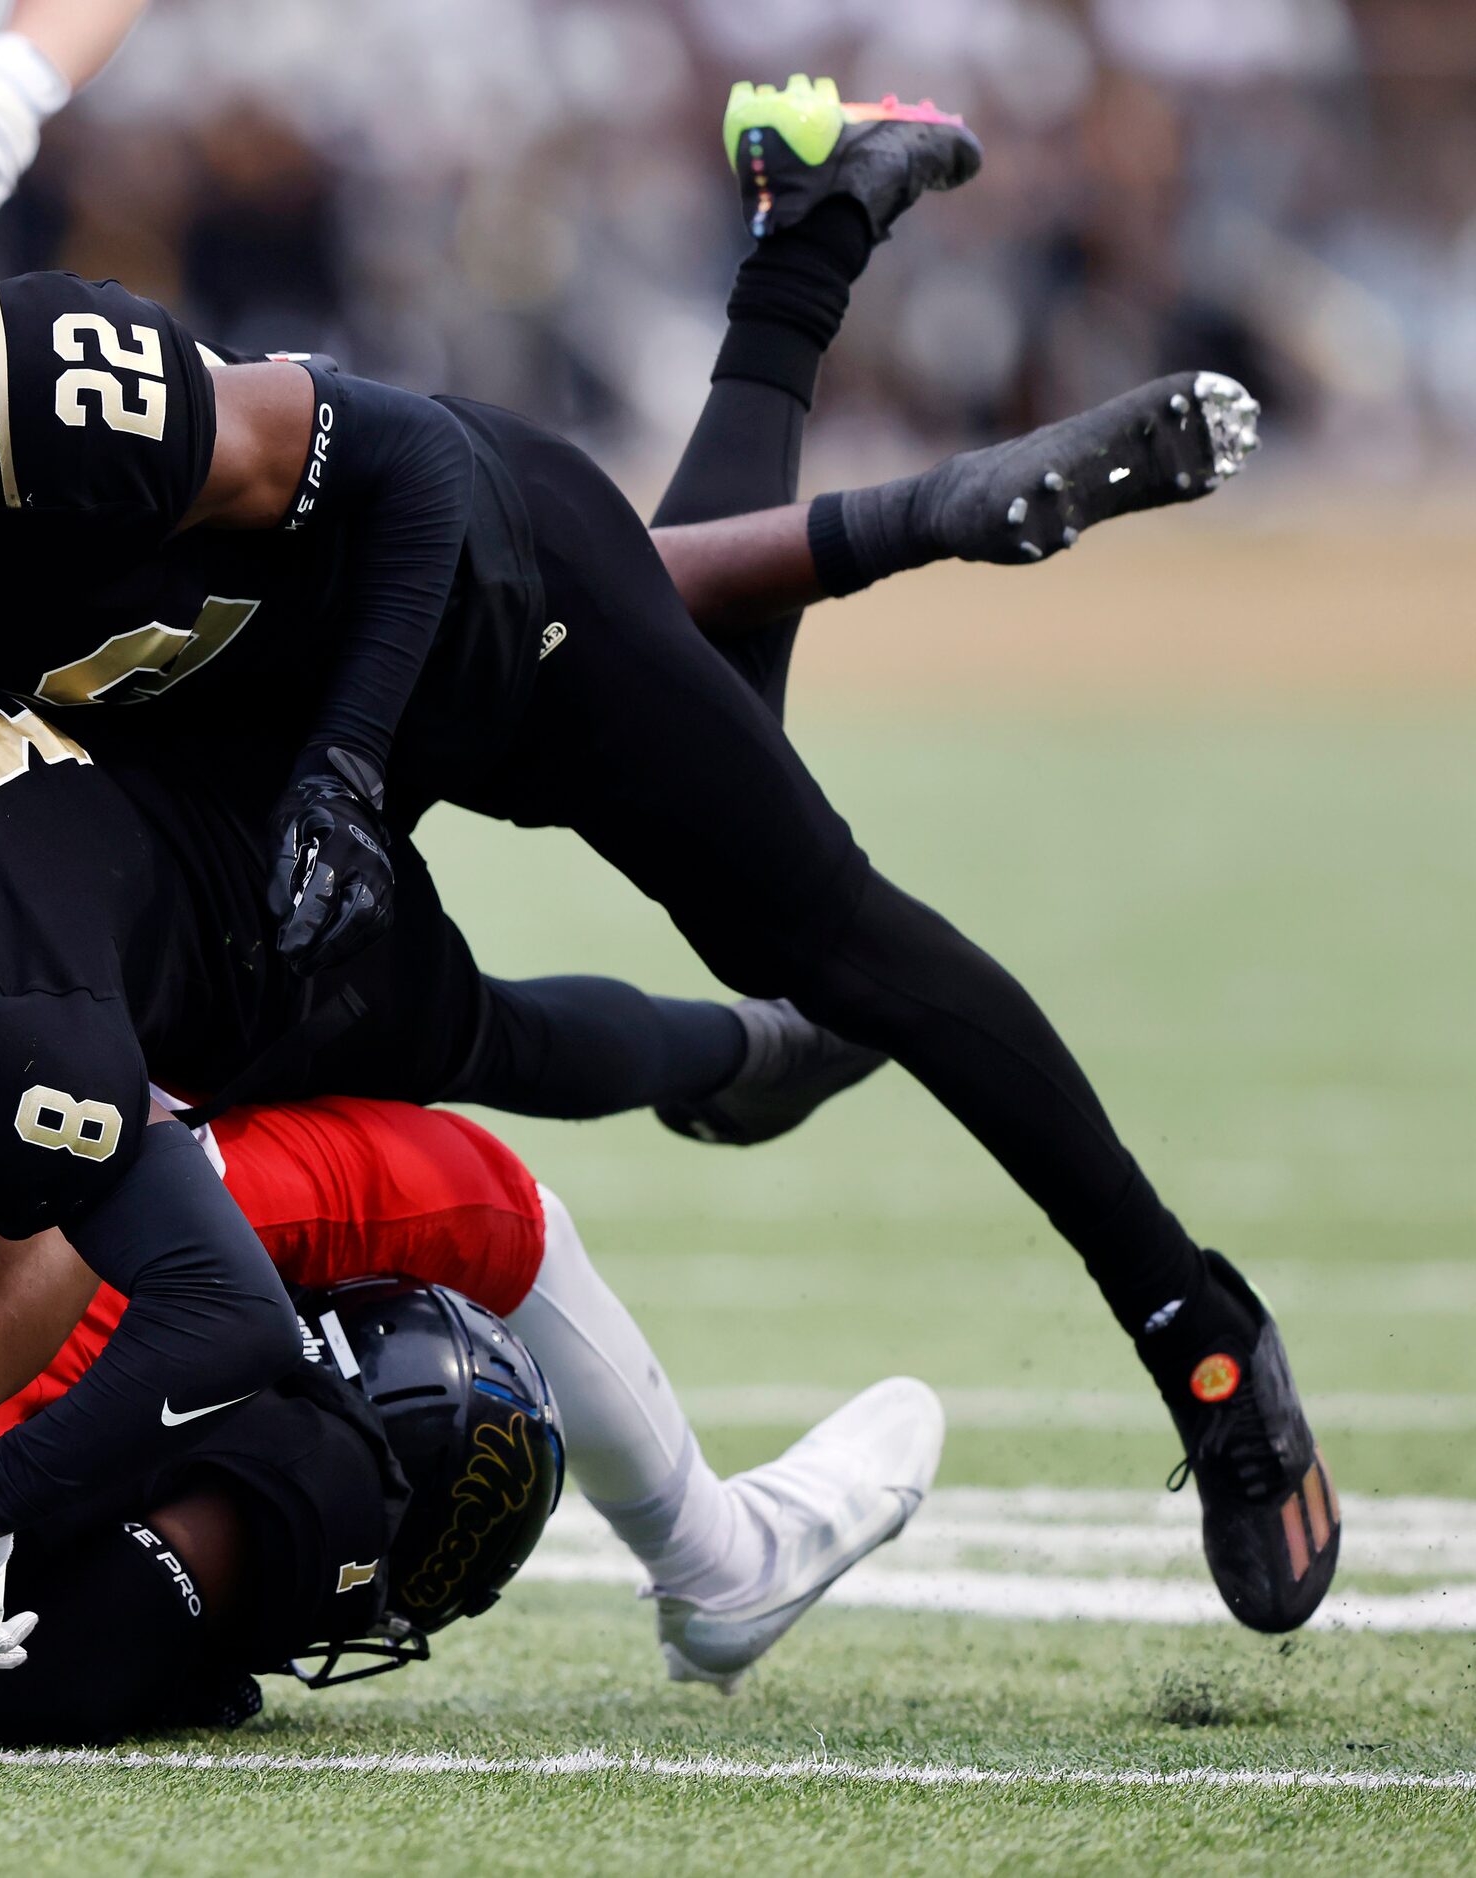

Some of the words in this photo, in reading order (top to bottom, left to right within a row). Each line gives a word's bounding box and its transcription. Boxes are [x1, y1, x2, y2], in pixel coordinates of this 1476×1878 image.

[52, 311, 168, 441] 22
[308, 402, 334, 488] PRO
[14, 1084, 123, 1163] 8
[156, 1551, 201, 1617] PRO
[336, 1558, 379, 1594] 1
